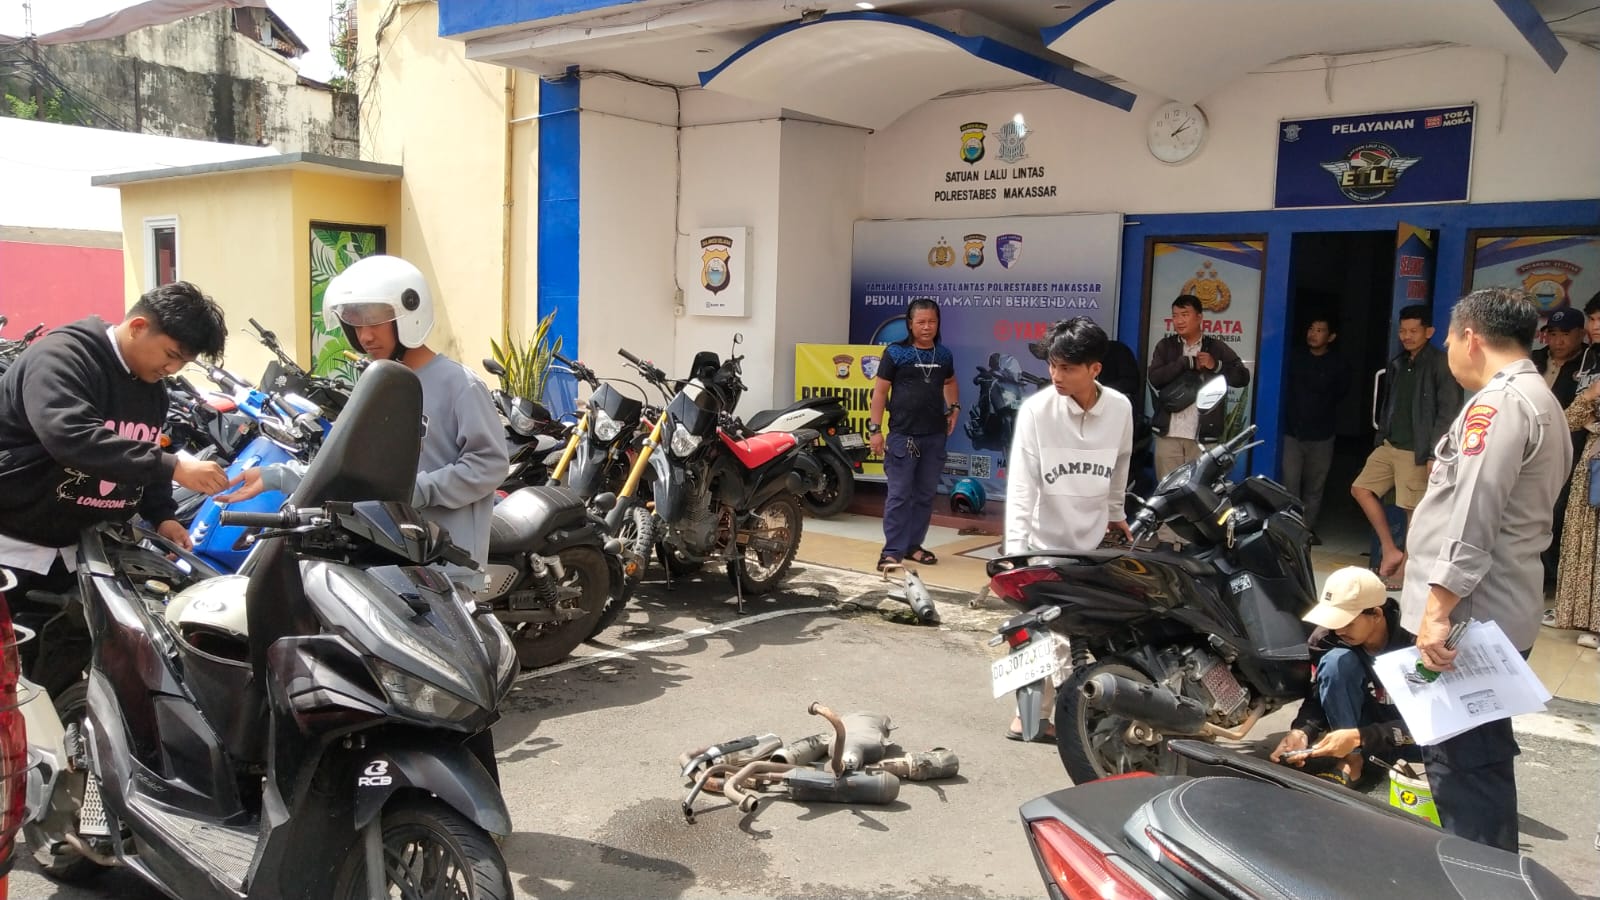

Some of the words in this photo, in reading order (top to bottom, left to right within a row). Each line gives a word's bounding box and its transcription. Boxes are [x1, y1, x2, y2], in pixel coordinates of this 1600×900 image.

[1332, 119, 1414, 134] PELAYANAN
[945, 171, 979, 182] SATUAN
[984, 168, 1008, 180] LALU
[1012, 166, 1045, 179] LINTAS
[1342, 168, 1395, 186] ETLE
[934, 188, 997, 202] POLRESTABES
[1003, 185, 1057, 199] MAKASSAR
[866, 283, 896, 292] YAMAHA
[898, 283, 934, 292] BERSAMA
[937, 283, 985, 292] SATLANTAS
[987, 283, 1048, 292] POLRESTABES
[1051, 283, 1102, 293] MAKASSAR
[865, 295, 904, 306] PEDULI
[1006, 296, 1099, 309] BERKENDARA
[1044, 462, 1113, 484] CHAMPION
[1008, 651, 1030, 673] 3072
[358, 776, 392, 787] RCB
